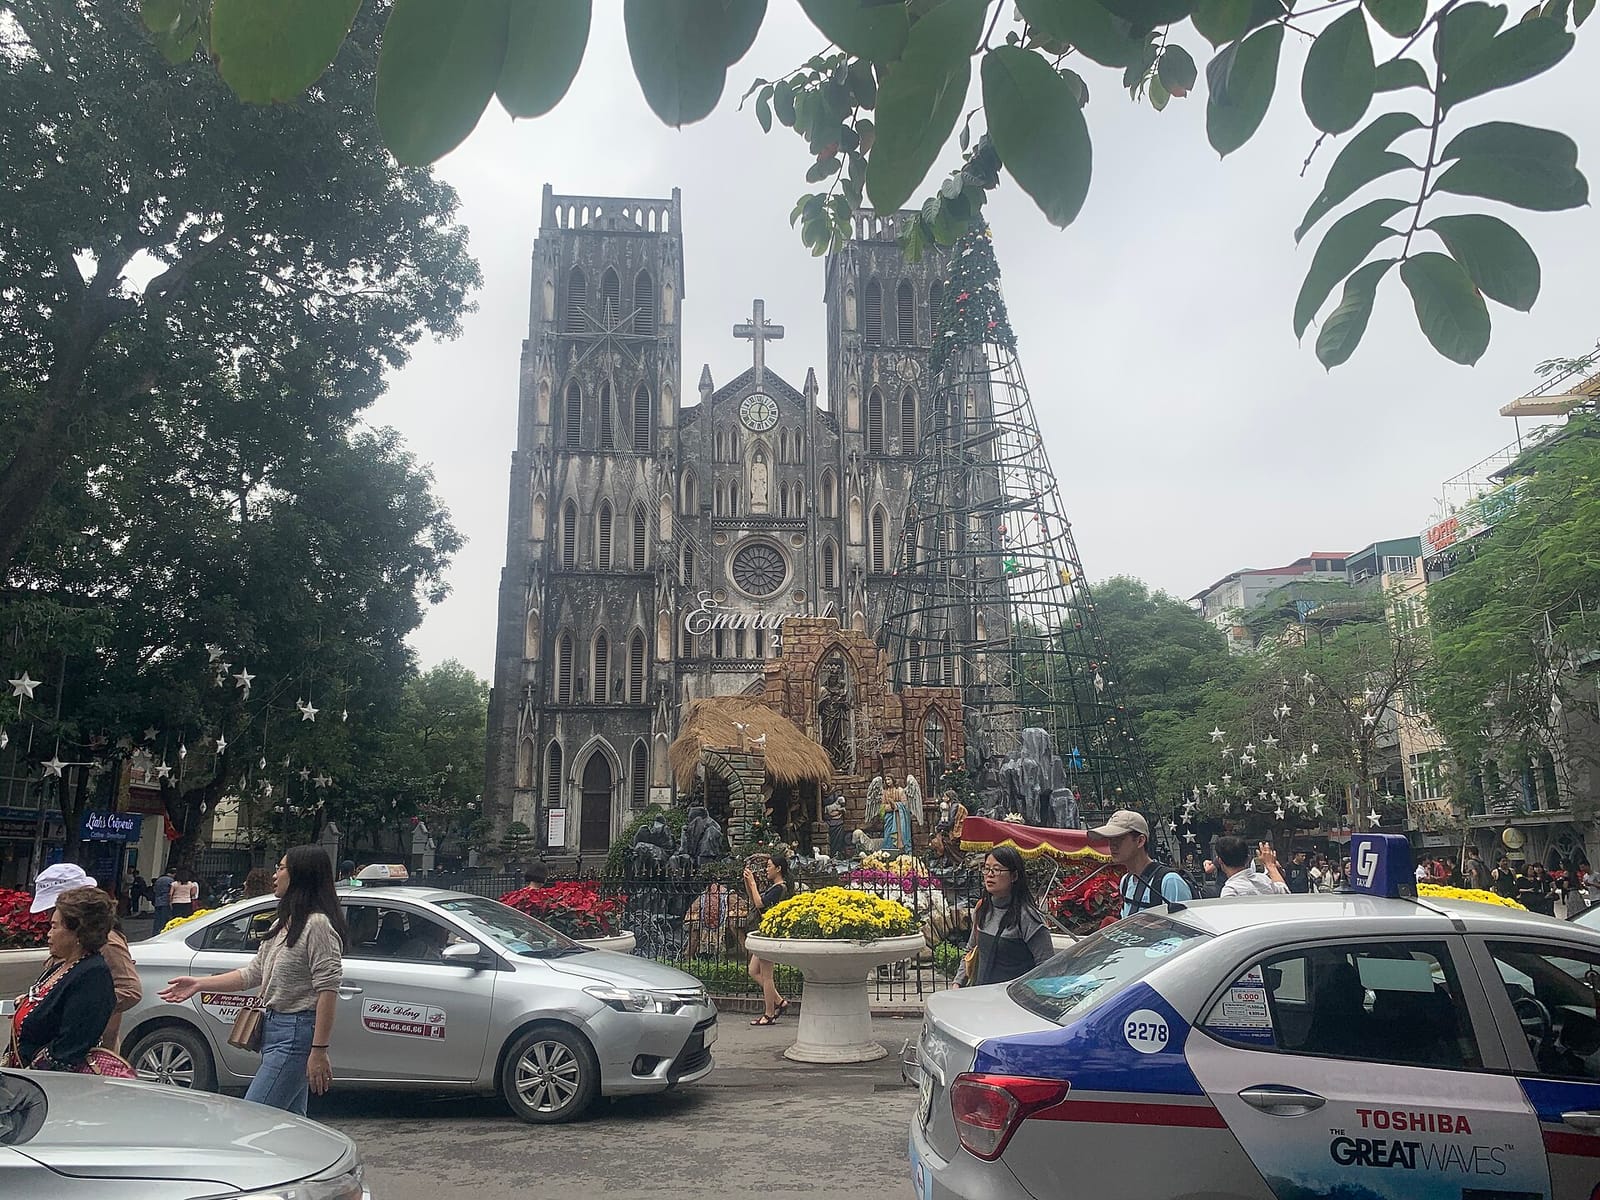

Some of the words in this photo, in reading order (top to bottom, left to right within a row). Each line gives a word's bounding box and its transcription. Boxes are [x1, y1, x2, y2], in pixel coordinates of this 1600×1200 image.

[1357, 842, 1379, 888] G7
[1128, 1021, 1168, 1042] 2278
[1329, 1128, 1345, 1136] THE
[1356, 1108, 1473, 1135] TOSHIBA
